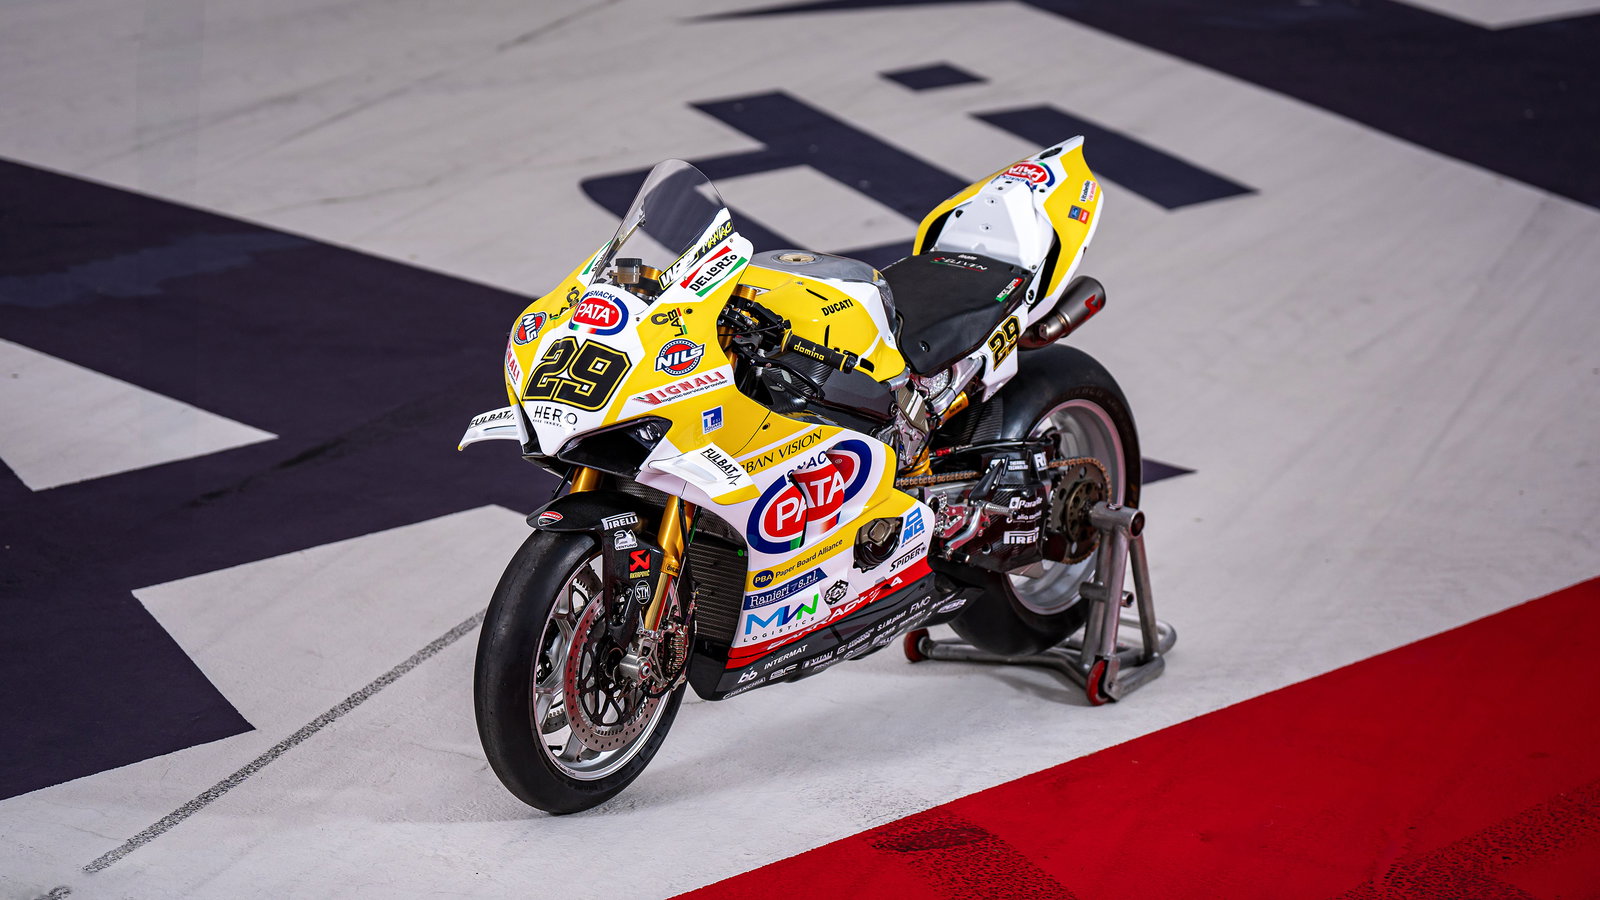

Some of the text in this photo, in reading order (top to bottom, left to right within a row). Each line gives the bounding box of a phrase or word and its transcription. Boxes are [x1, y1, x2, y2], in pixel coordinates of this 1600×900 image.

[689, 253, 738, 292] DELLORTO
[588, 290, 615, 302] SNACK
[821, 299, 854, 316] DUCATI
[576, 303, 610, 324] PATA
[522, 313, 538, 344] NILS
[793, 341, 825, 361] domino
[988, 315, 1021, 372] 29
[656, 345, 704, 370] NILS
[521, 336, 633, 413] 29
[632, 371, 726, 406] VIGNALI
[470, 410, 512, 427] FULBAT
[533, 405, 578, 426] HERO
[778, 429, 823, 459] VISION
[700, 447, 740, 478] FULBAT
[776, 472, 846, 532] PATA
[601, 512, 639, 531] PIRELLI
[754, 539, 843, 585] PBA Paper Board Alliance
[889, 542, 922, 573] SPIDER
[749, 583, 790, 609] Ranieri
[743, 616, 815, 643] LOGISTICS
[763, 644, 809, 671] INTERMAT
